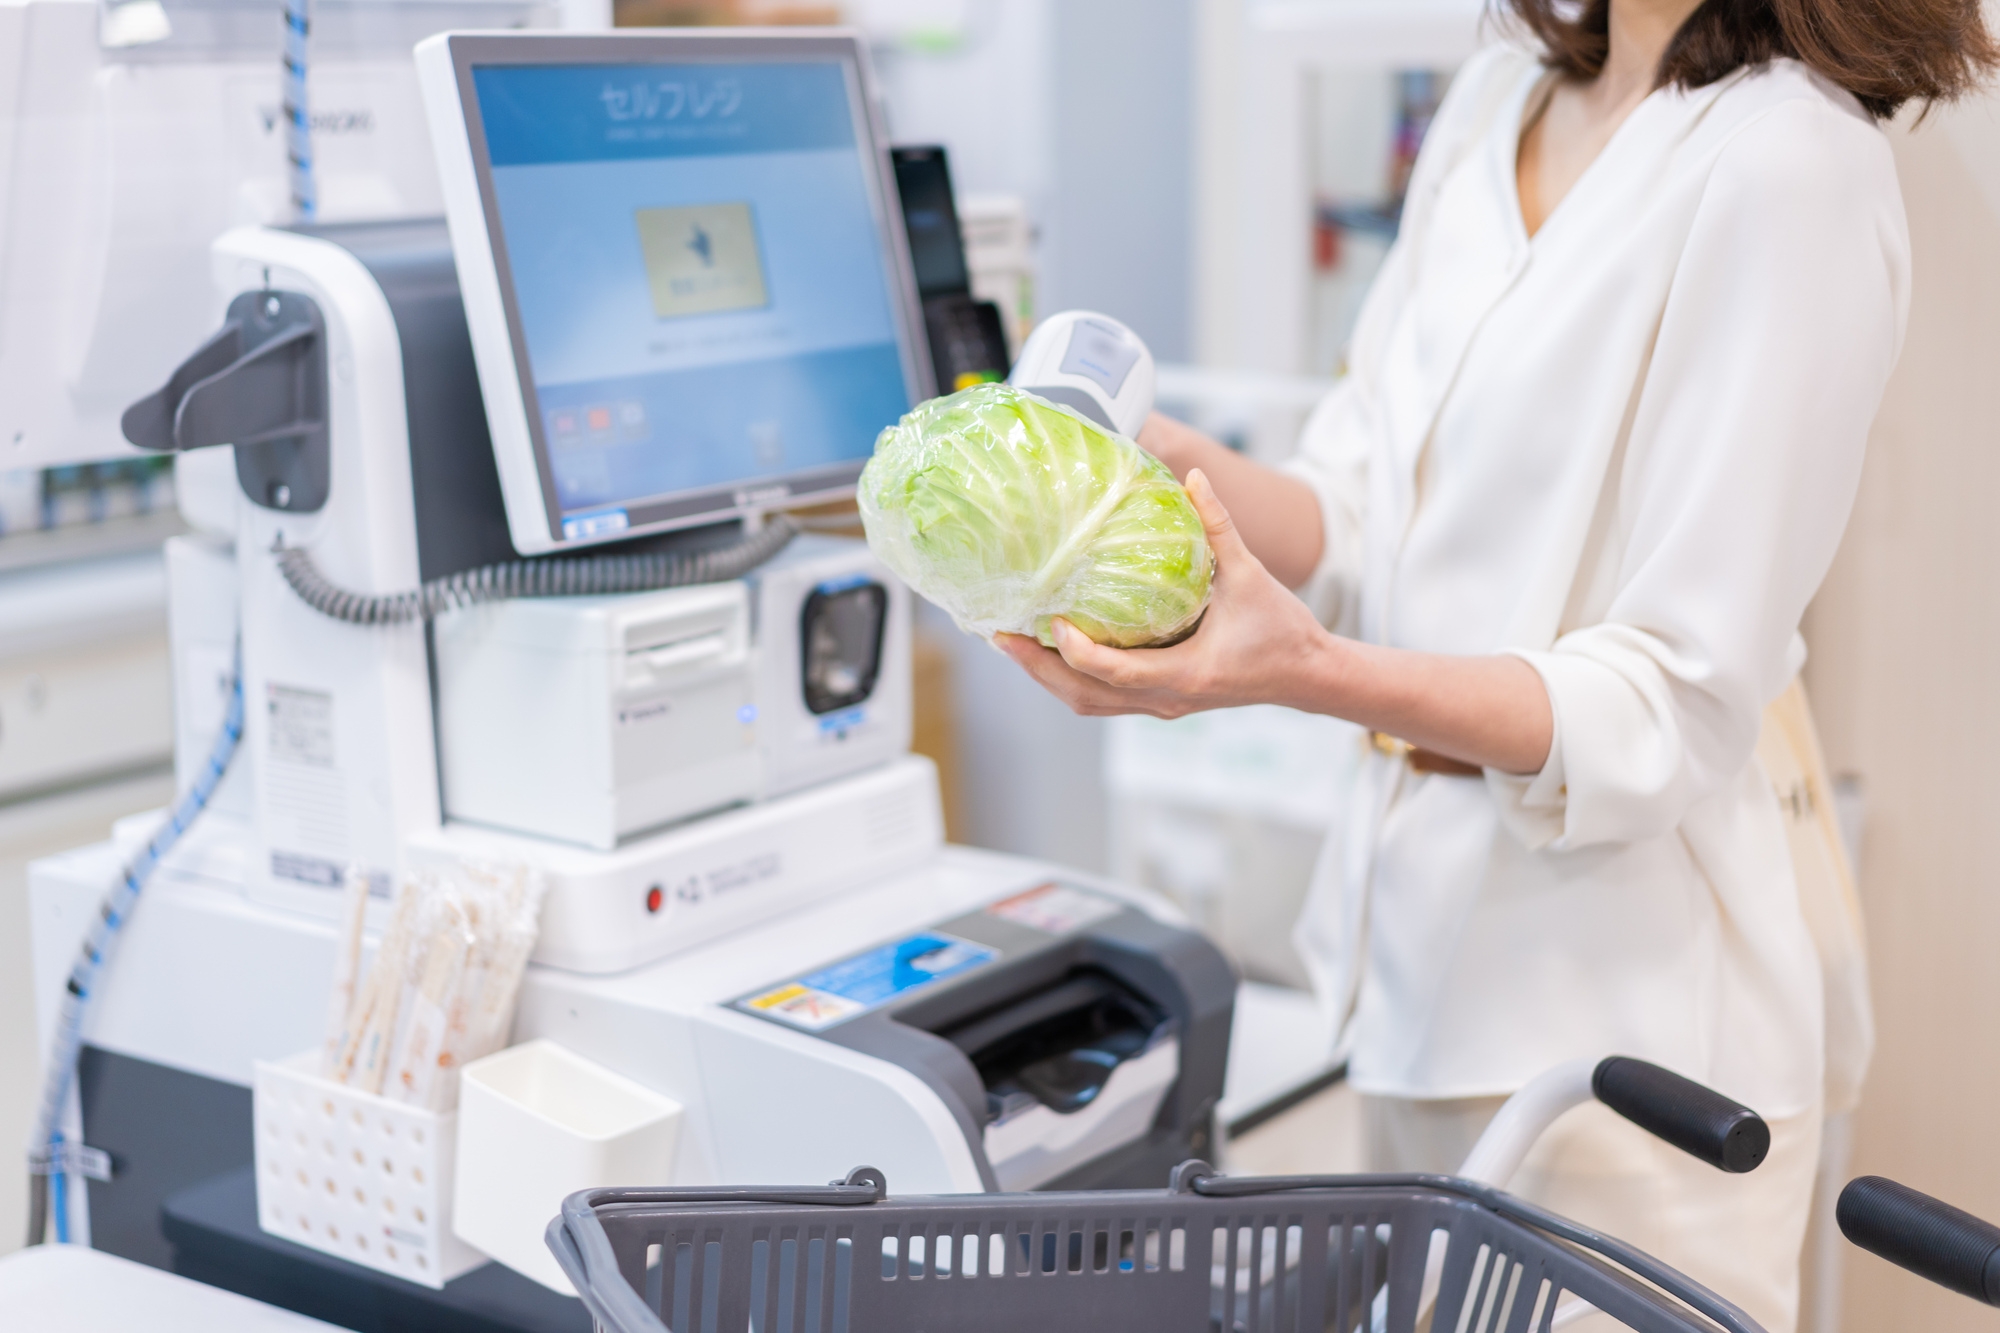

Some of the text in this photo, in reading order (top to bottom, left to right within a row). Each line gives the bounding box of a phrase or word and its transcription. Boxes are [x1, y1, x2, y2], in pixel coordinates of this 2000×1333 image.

[600, 80, 744, 121] セルフレジ
